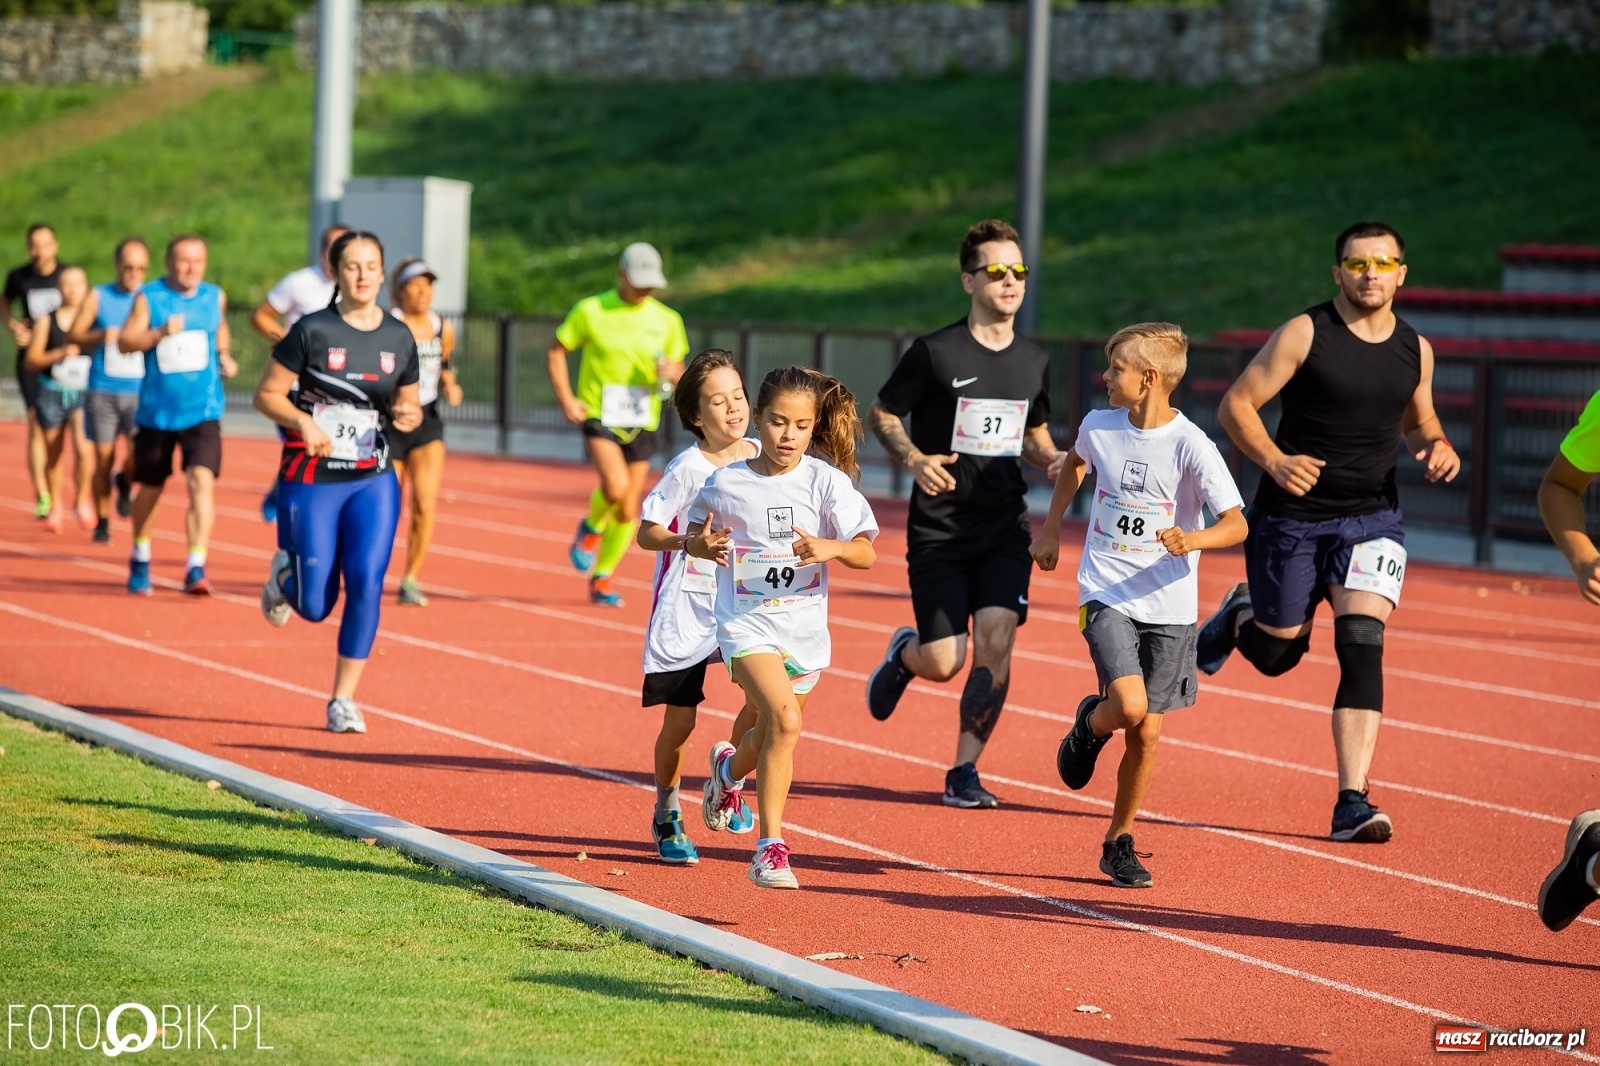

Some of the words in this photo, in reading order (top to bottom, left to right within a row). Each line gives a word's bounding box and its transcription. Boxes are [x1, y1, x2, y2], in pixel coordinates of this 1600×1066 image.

[335, 423, 357, 440] 39
[982, 417, 1002, 435] 37
[1116, 514, 1145, 537] 48
[764, 566, 795, 589] 49
[1376, 554, 1403, 582] 100
